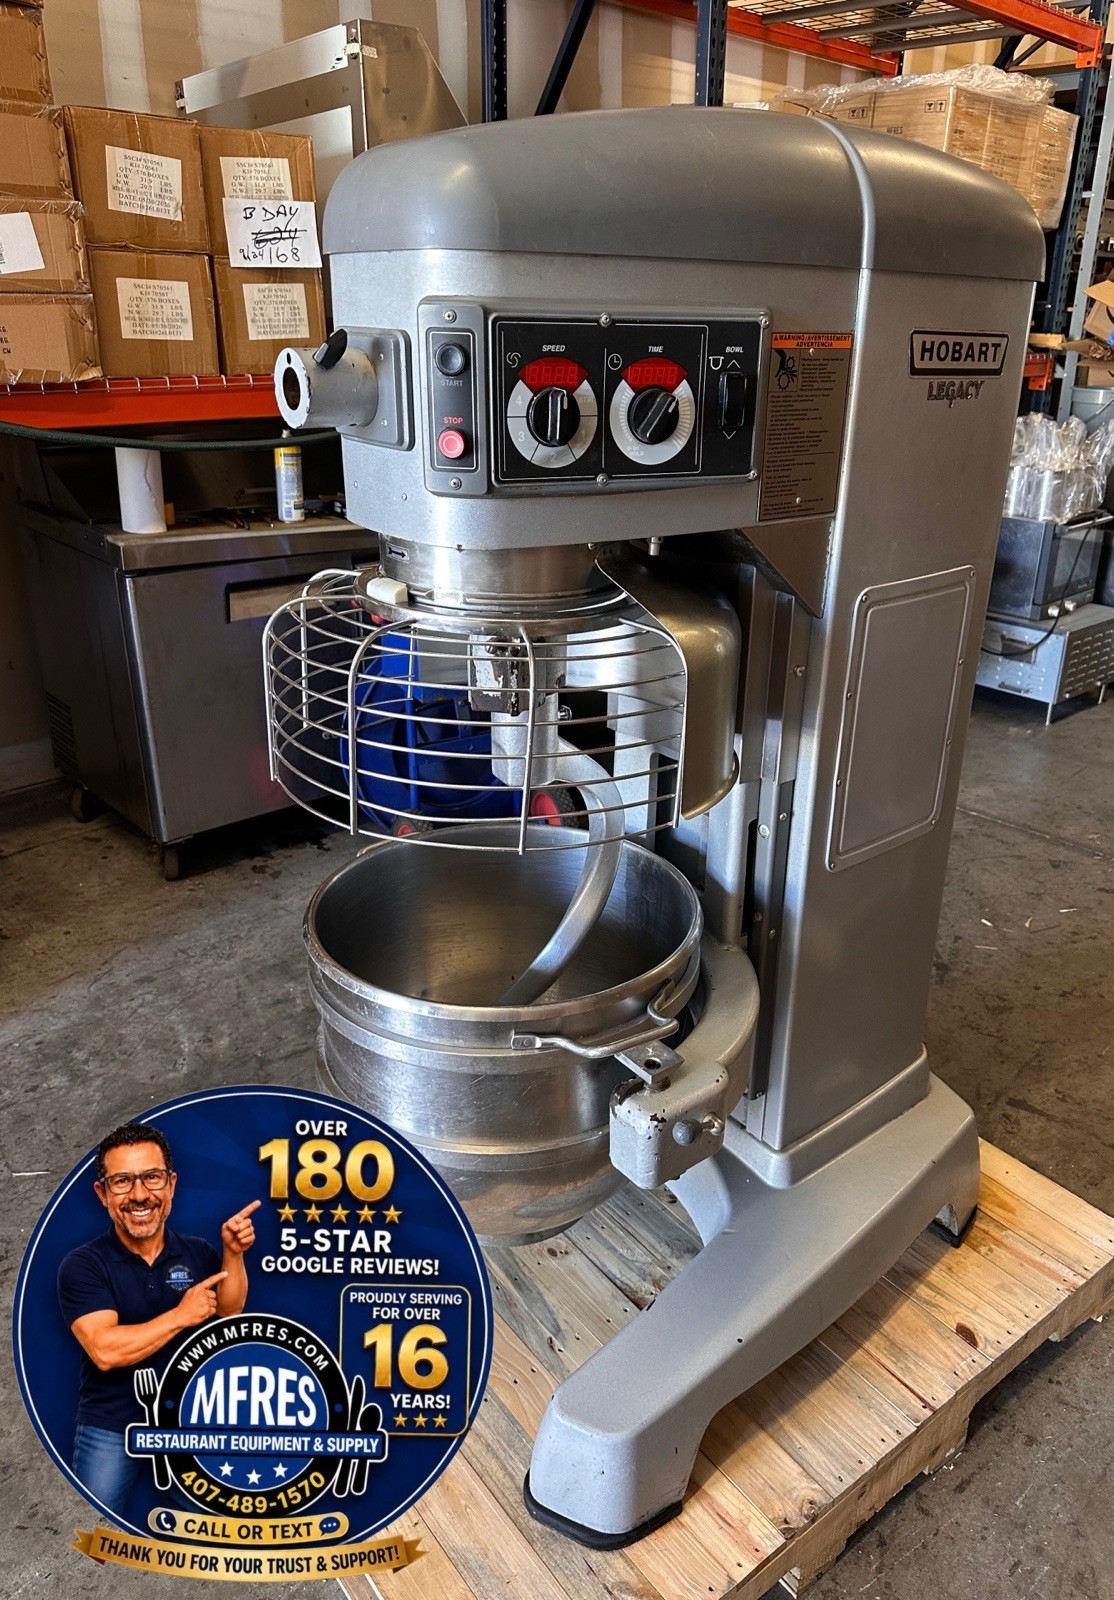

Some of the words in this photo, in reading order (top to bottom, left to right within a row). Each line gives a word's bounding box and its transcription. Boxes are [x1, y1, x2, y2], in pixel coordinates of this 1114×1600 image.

[147, 172, 170, 180] BOXES
[262, 204, 299, 232] DAY
[541, 344, 566, 352] SPEED
[648, 345, 664, 353] TIME
[919, 340, 1002, 362] HOBART
[440, 379, 464, 387] START
[926, 380, 986, 409] LEGACY
[515, 395, 523, 406] 4
[443, 416, 463, 424] STOP
[518, 432, 525, 442] 3
